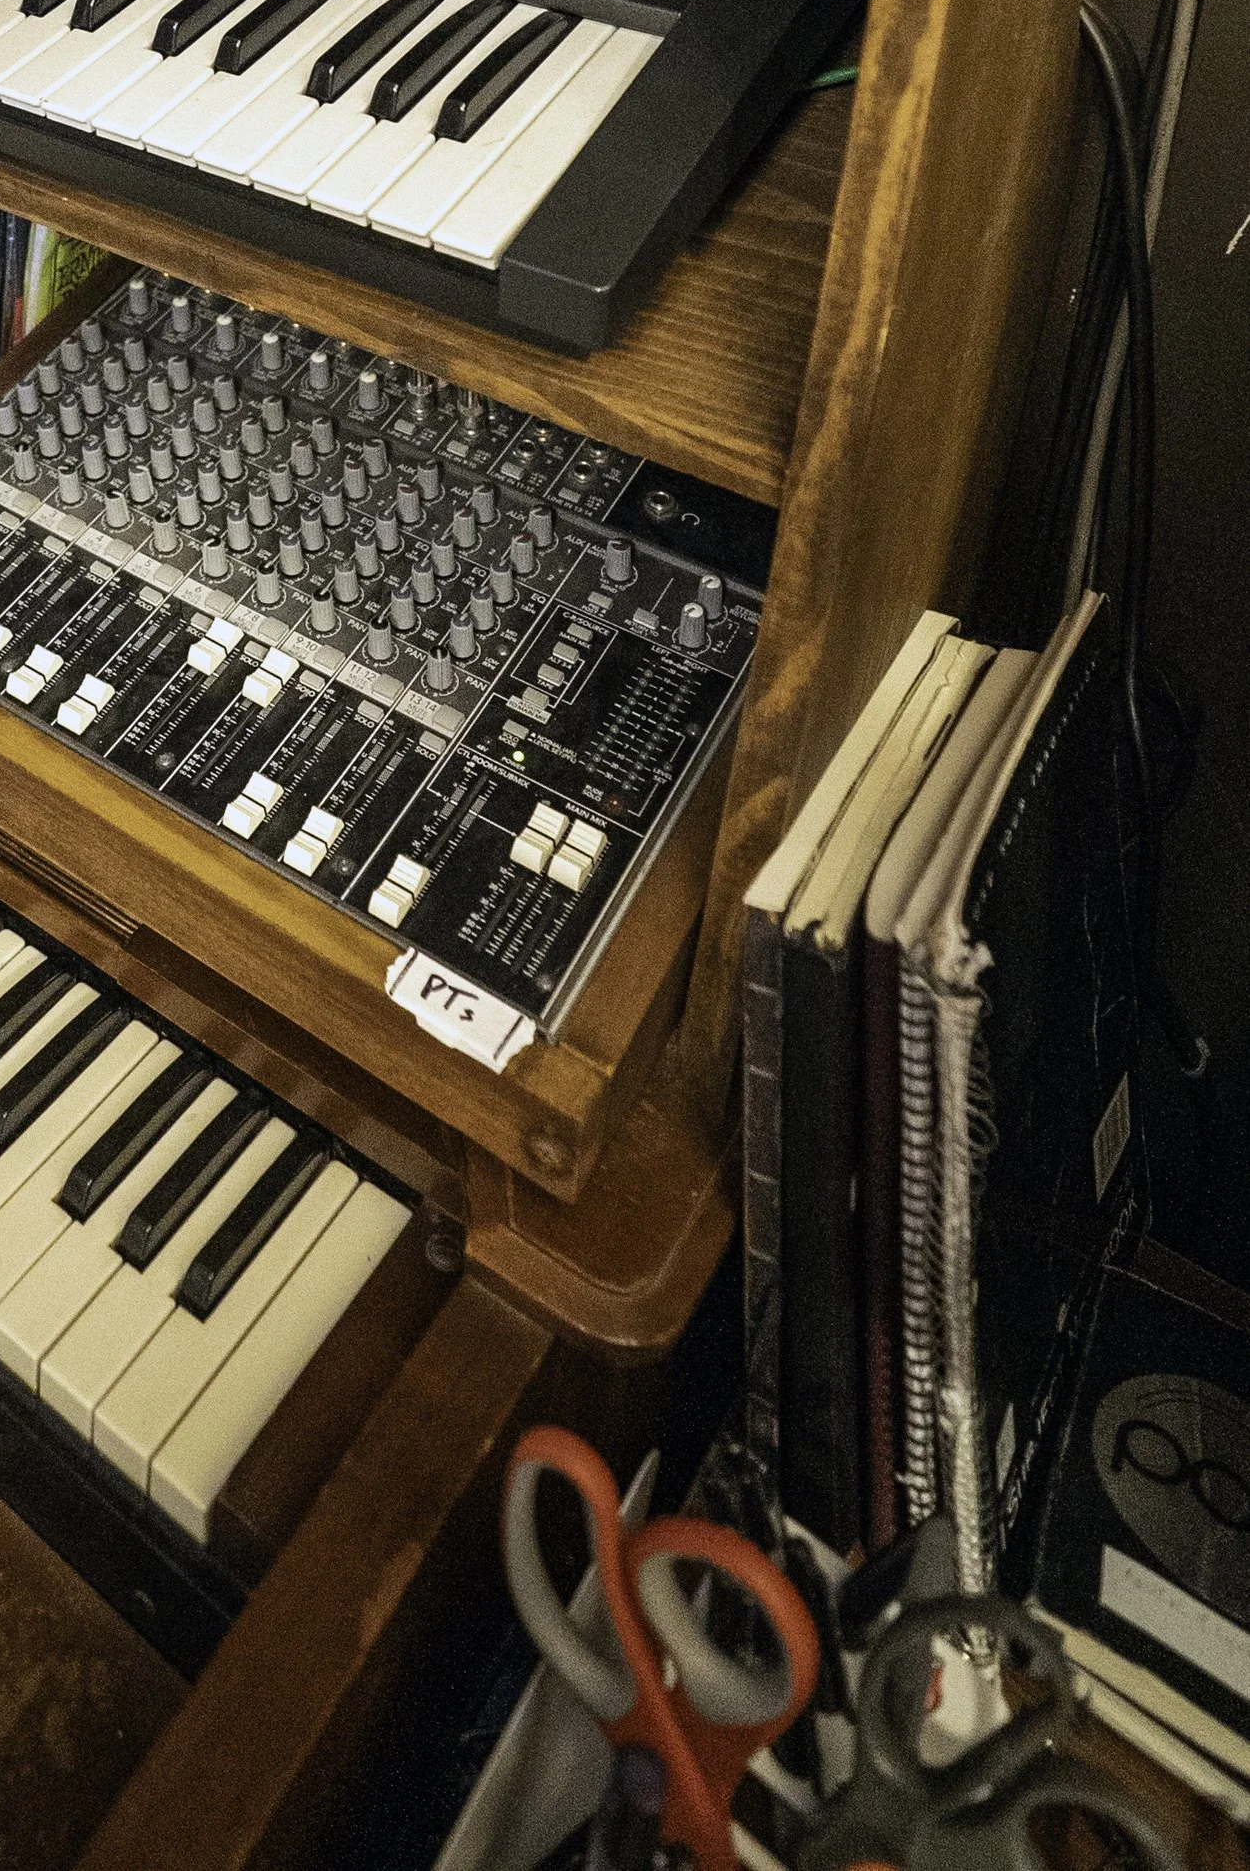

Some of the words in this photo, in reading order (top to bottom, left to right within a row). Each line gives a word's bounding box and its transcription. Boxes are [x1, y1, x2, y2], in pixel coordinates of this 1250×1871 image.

[564, 534, 586, 547] AUX
[85, 572, 103, 584] SOLO
[134, 598, 154, 611] SOLO
[292, 592, 311, 605] PAN
[185, 626, 205, 638] SOLO
[347, 619, 368, 633] PAN
[558, 631, 579, 644] MAIN
[578, 639, 592, 649] MIX
[404, 646, 427, 662] PAN
[651, 645, 671, 657] LEFT
[239, 654, 260, 667] SOLO
[683, 659, 710, 674] RIGHT
[465, 676, 488, 691] PAN
[536, 679, 554, 690] TAPE
[353, 713, 375, 728] SOLO
[414, 745, 437, 761] SOLO
[456, 747, 471, 759] CTL
[470, 754, 531, 789] ROOM/SUBMIX
[653, 767, 673, 779] LEVEL
[565, 802, 591, 819] MAIN
[589, 814, 608, 828] MIX
